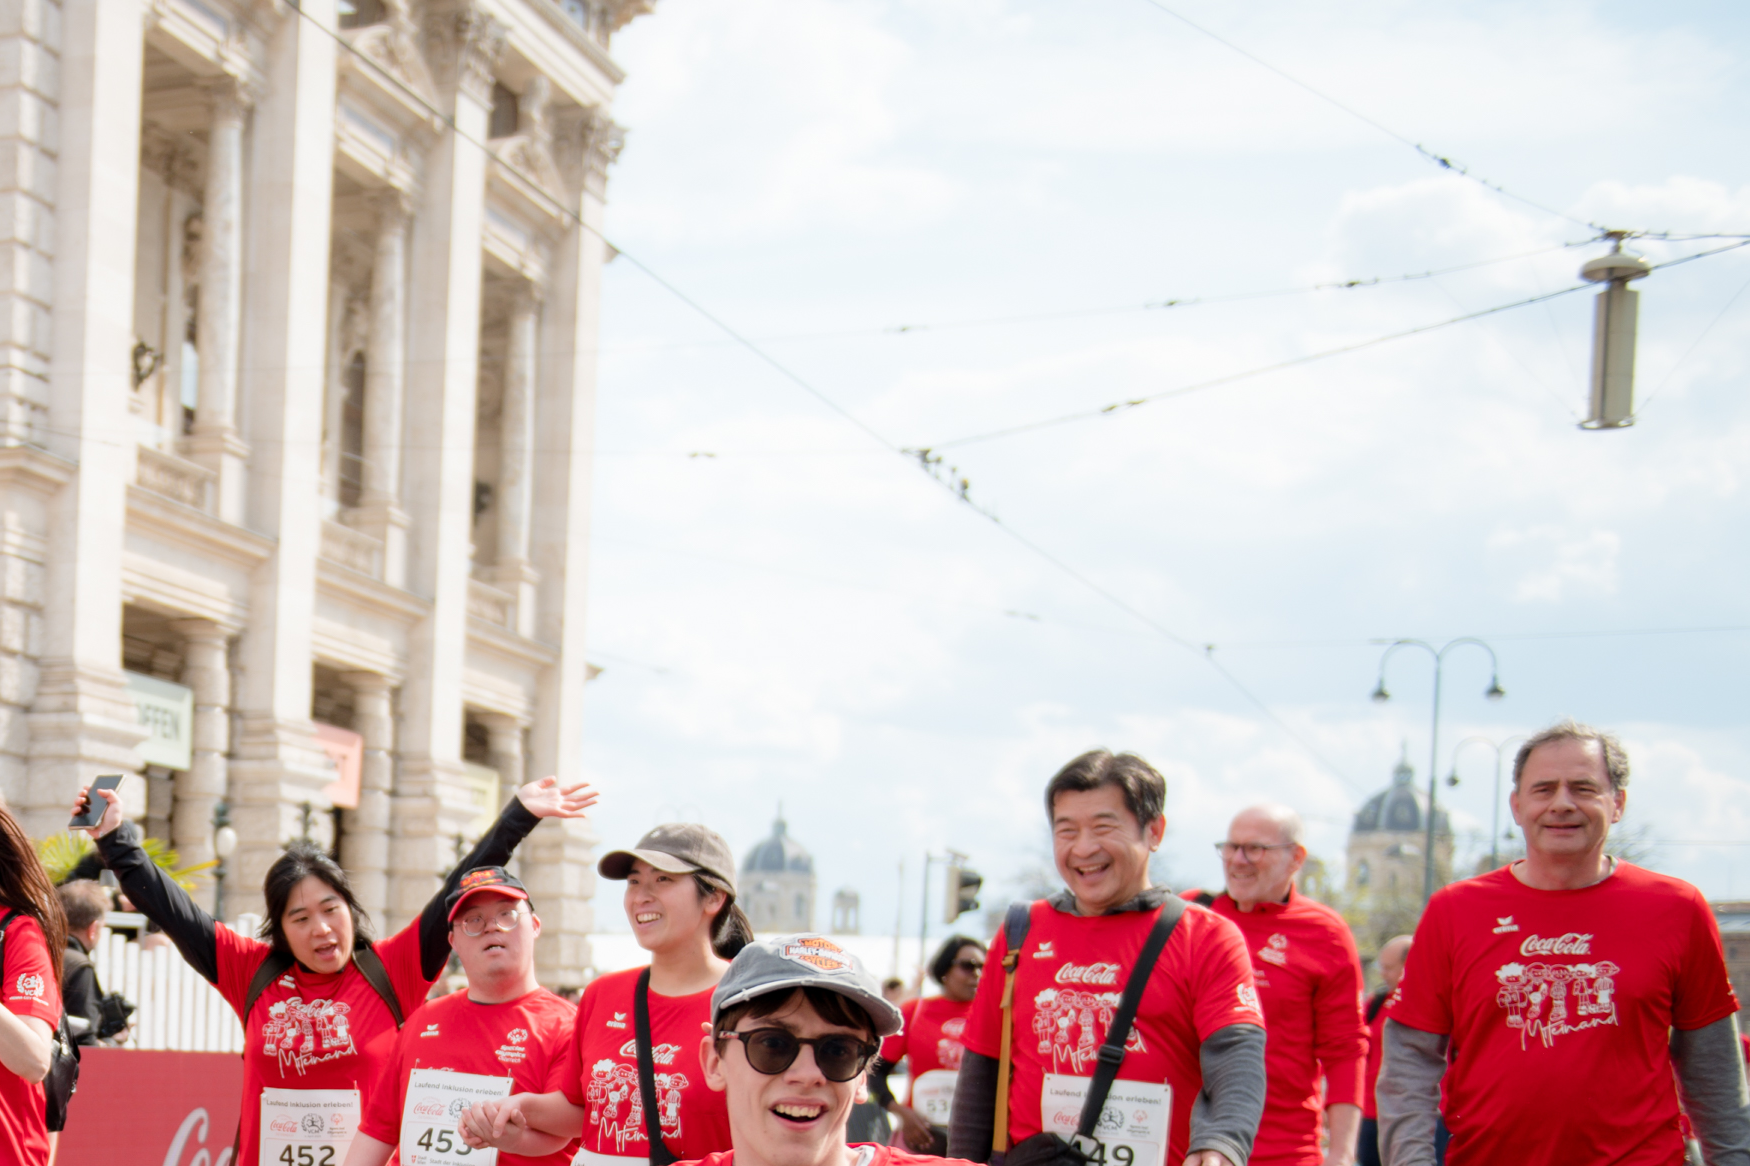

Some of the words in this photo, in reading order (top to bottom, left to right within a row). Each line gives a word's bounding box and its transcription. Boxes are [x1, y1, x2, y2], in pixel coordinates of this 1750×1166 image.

[1520, 933, 1593, 956] Coca-Cola
[1055, 962, 1121, 984] Coca-Cola
[442, 1084, 473, 1093] Inklusion
